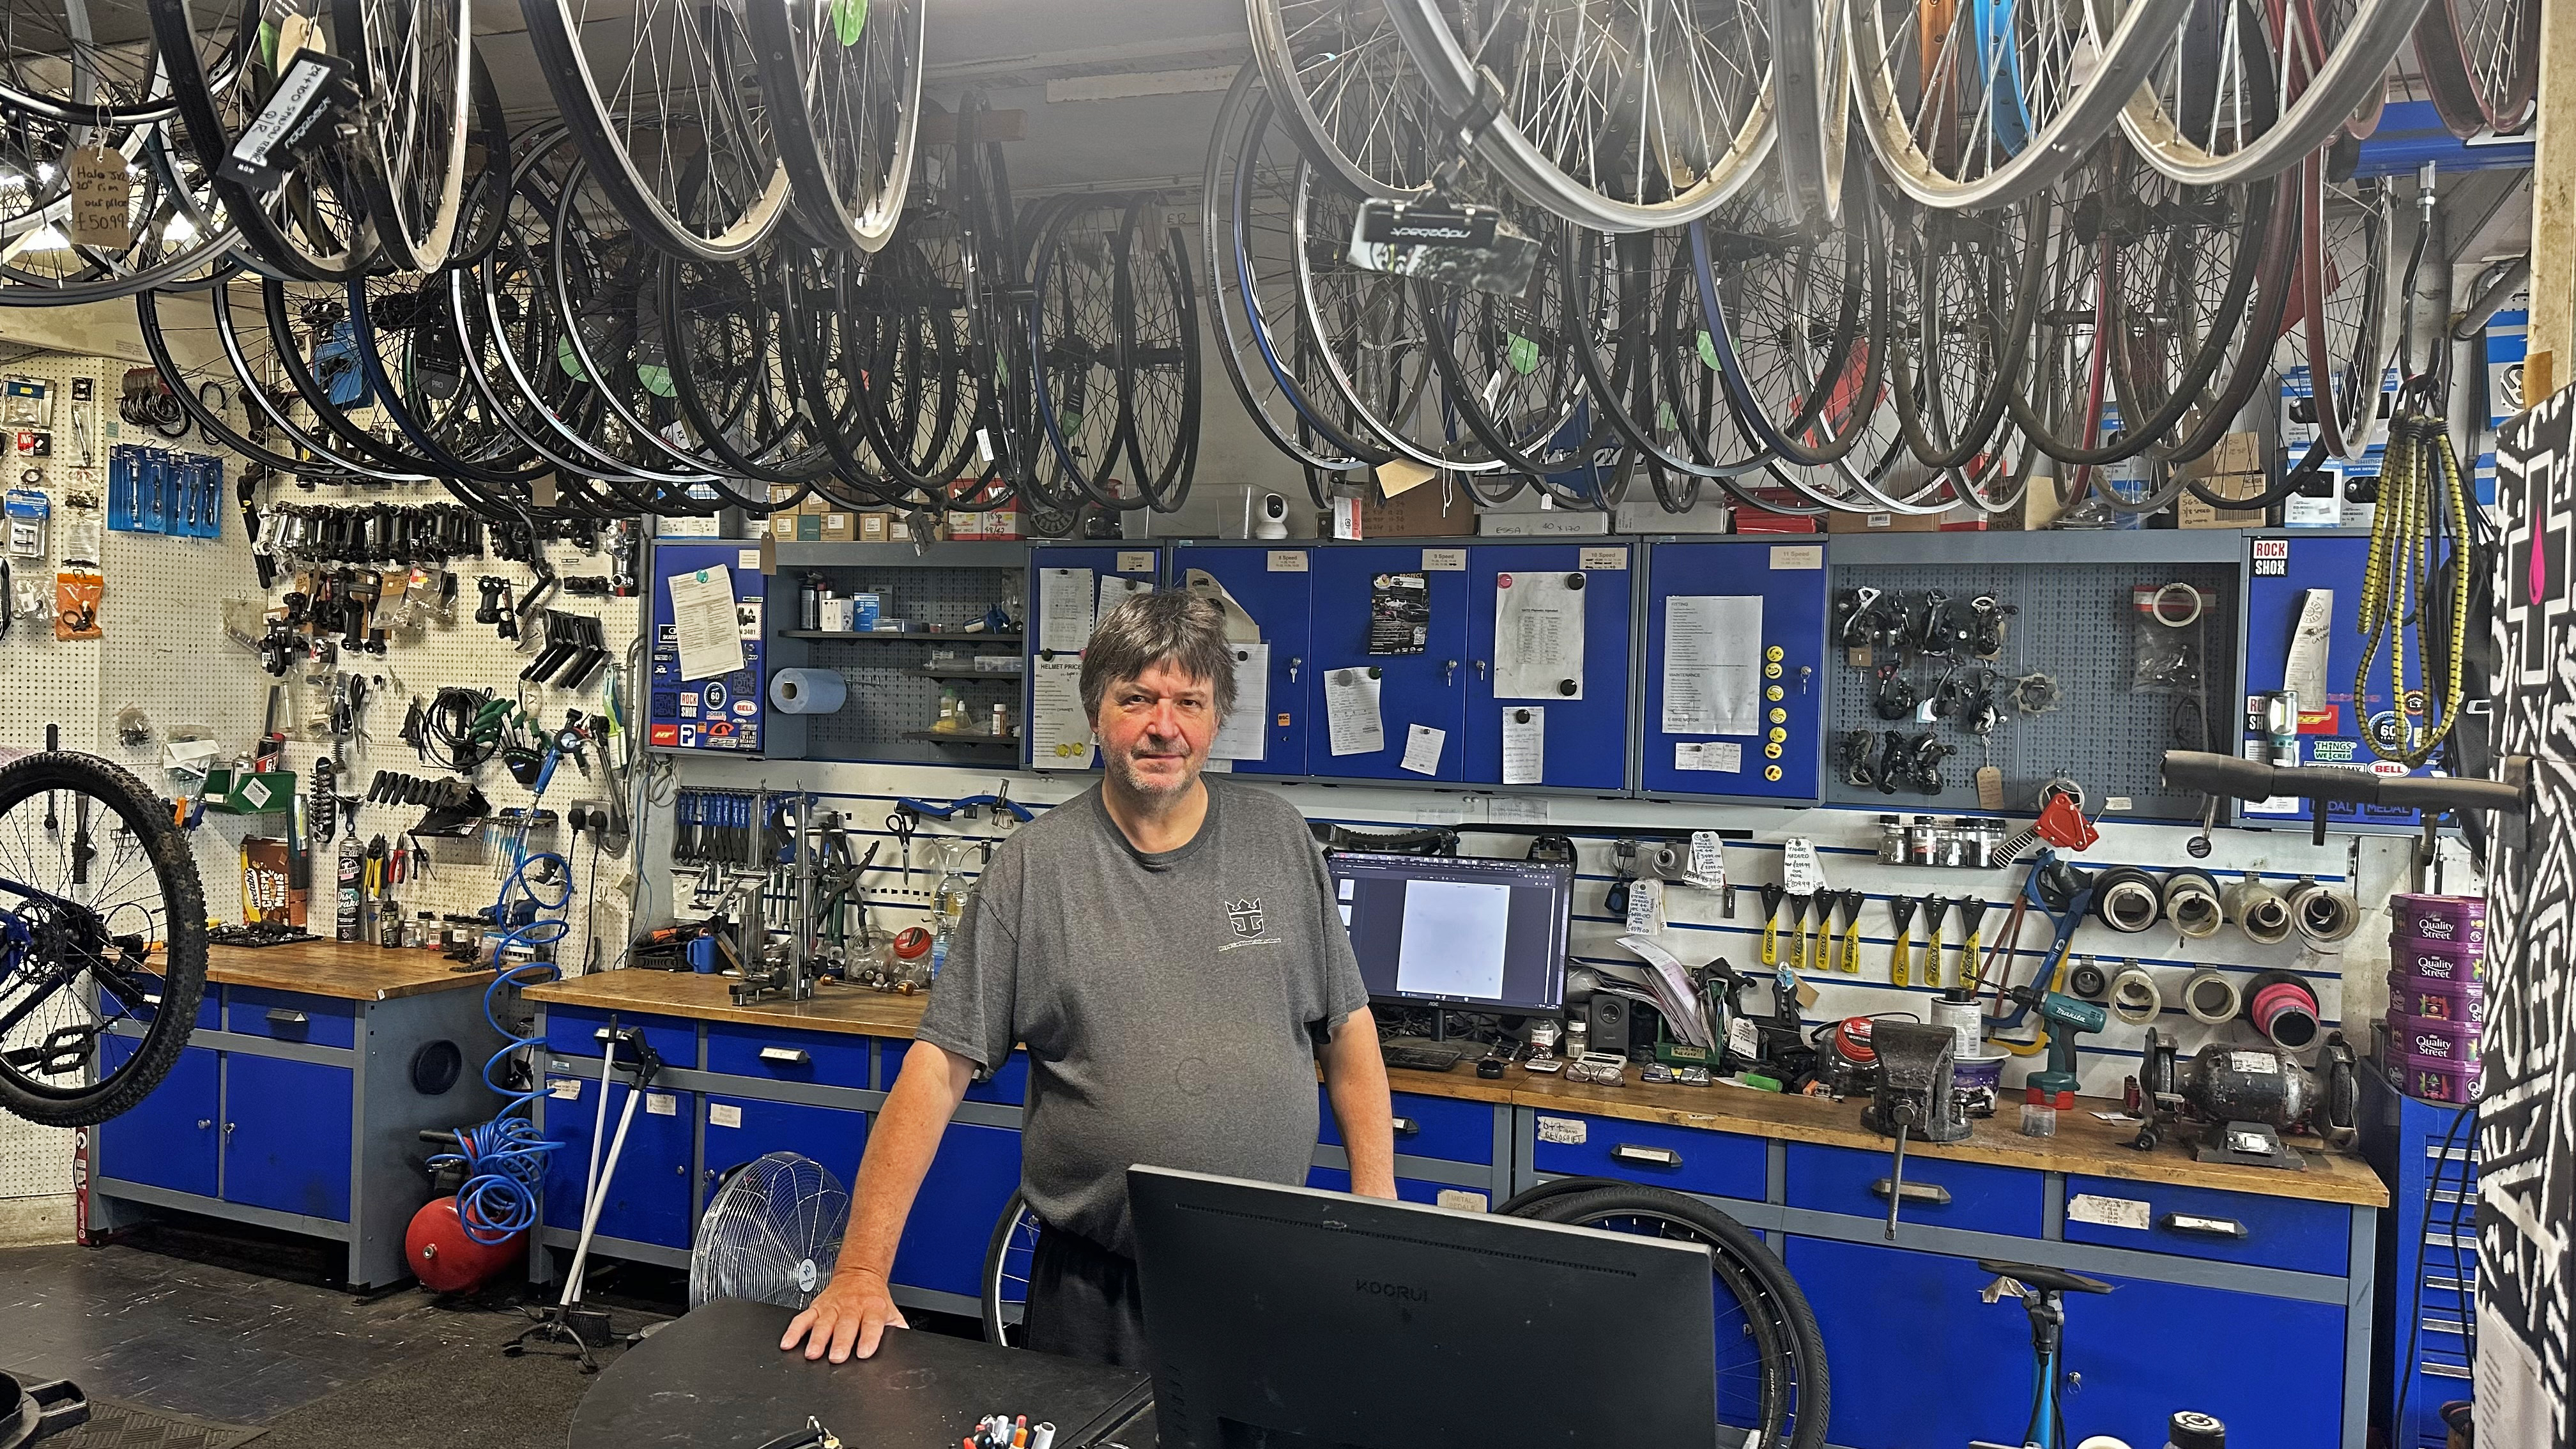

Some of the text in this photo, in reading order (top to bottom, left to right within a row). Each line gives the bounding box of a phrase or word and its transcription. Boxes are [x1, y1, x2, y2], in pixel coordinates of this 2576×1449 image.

[285, 96, 332, 149] ridgeback
[77, 166, 105, 178] Halo
[76, 211, 125, 231] £50.99
[1390, 227, 1471, 239] ridgeback
[2257, 543, 2285, 556] ROCK
[2255, 560, 2285, 575] SHOX
[682, 694, 697, 705] ROCK
[710, 692, 720, 700] 60
[245, 868, 260, 908] Weetabix
[261, 870, 272, 908] CRISPY
[274, 873, 284, 907] MINIS
[2419, 919, 2454, 933] Quality
[2422, 929, 2451, 940] Street
[2418, 957, 2454, 970] Quality
[2421, 967, 2450, 978] Street
[2056, 1006, 2085, 1023] makita
[2416, 1036, 2451, 1048] Quality
[2419, 1046, 2448, 1057] Street
[1451, 1195, 1473, 1203] METAL
